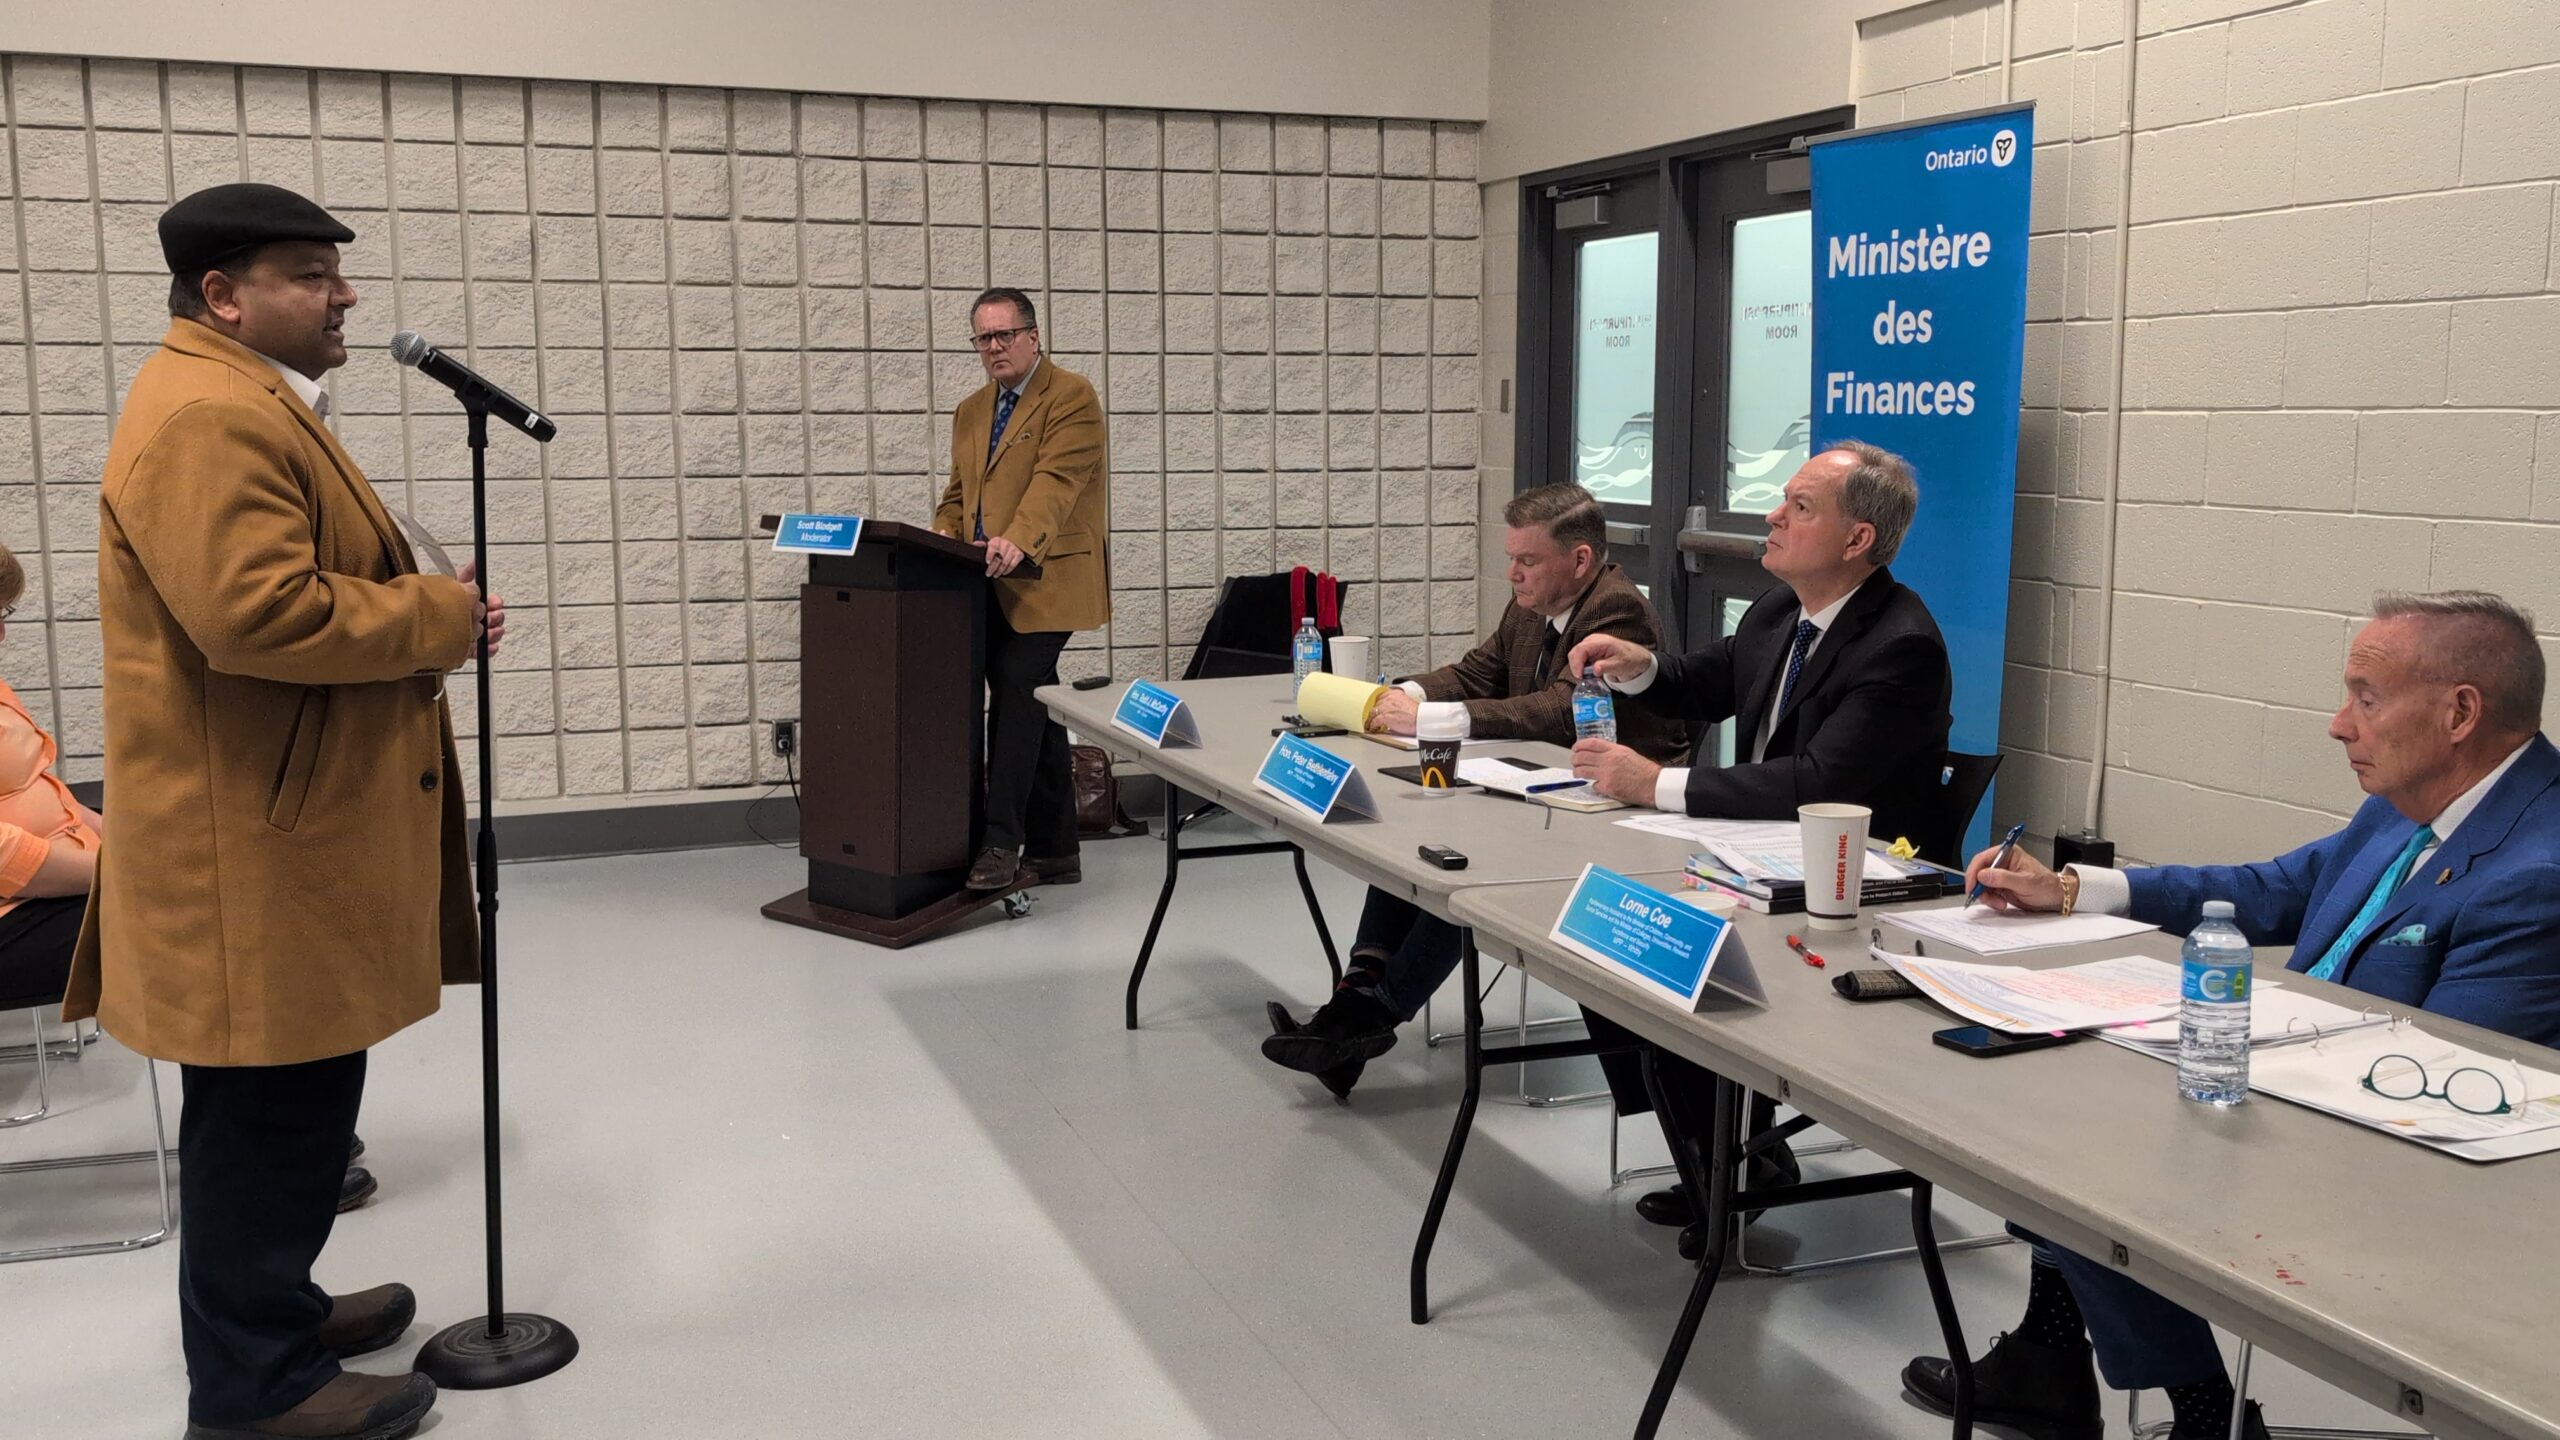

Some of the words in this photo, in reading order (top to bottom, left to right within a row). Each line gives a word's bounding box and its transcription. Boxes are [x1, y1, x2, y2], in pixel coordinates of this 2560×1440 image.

[1925, 146, 1988, 172] Ontario
[1828, 224, 1991, 279] Ministère
[1872, 300, 1933, 345] des
[1826, 371, 1976, 417] Finances
[797, 520, 815, 530] Scott
[801, 533, 832, 543] Moderator
[1279, 745, 1292, 759] Hon.
[1291, 750, 1308, 766] Peter
[1420, 747, 1452, 763] McCafé
[1838, 834, 1848, 860] KING
[1836, 862, 1846, 900] BURGER
[1619, 893, 1650, 918] Lorne
[1649, 906, 1672, 928] Coe
